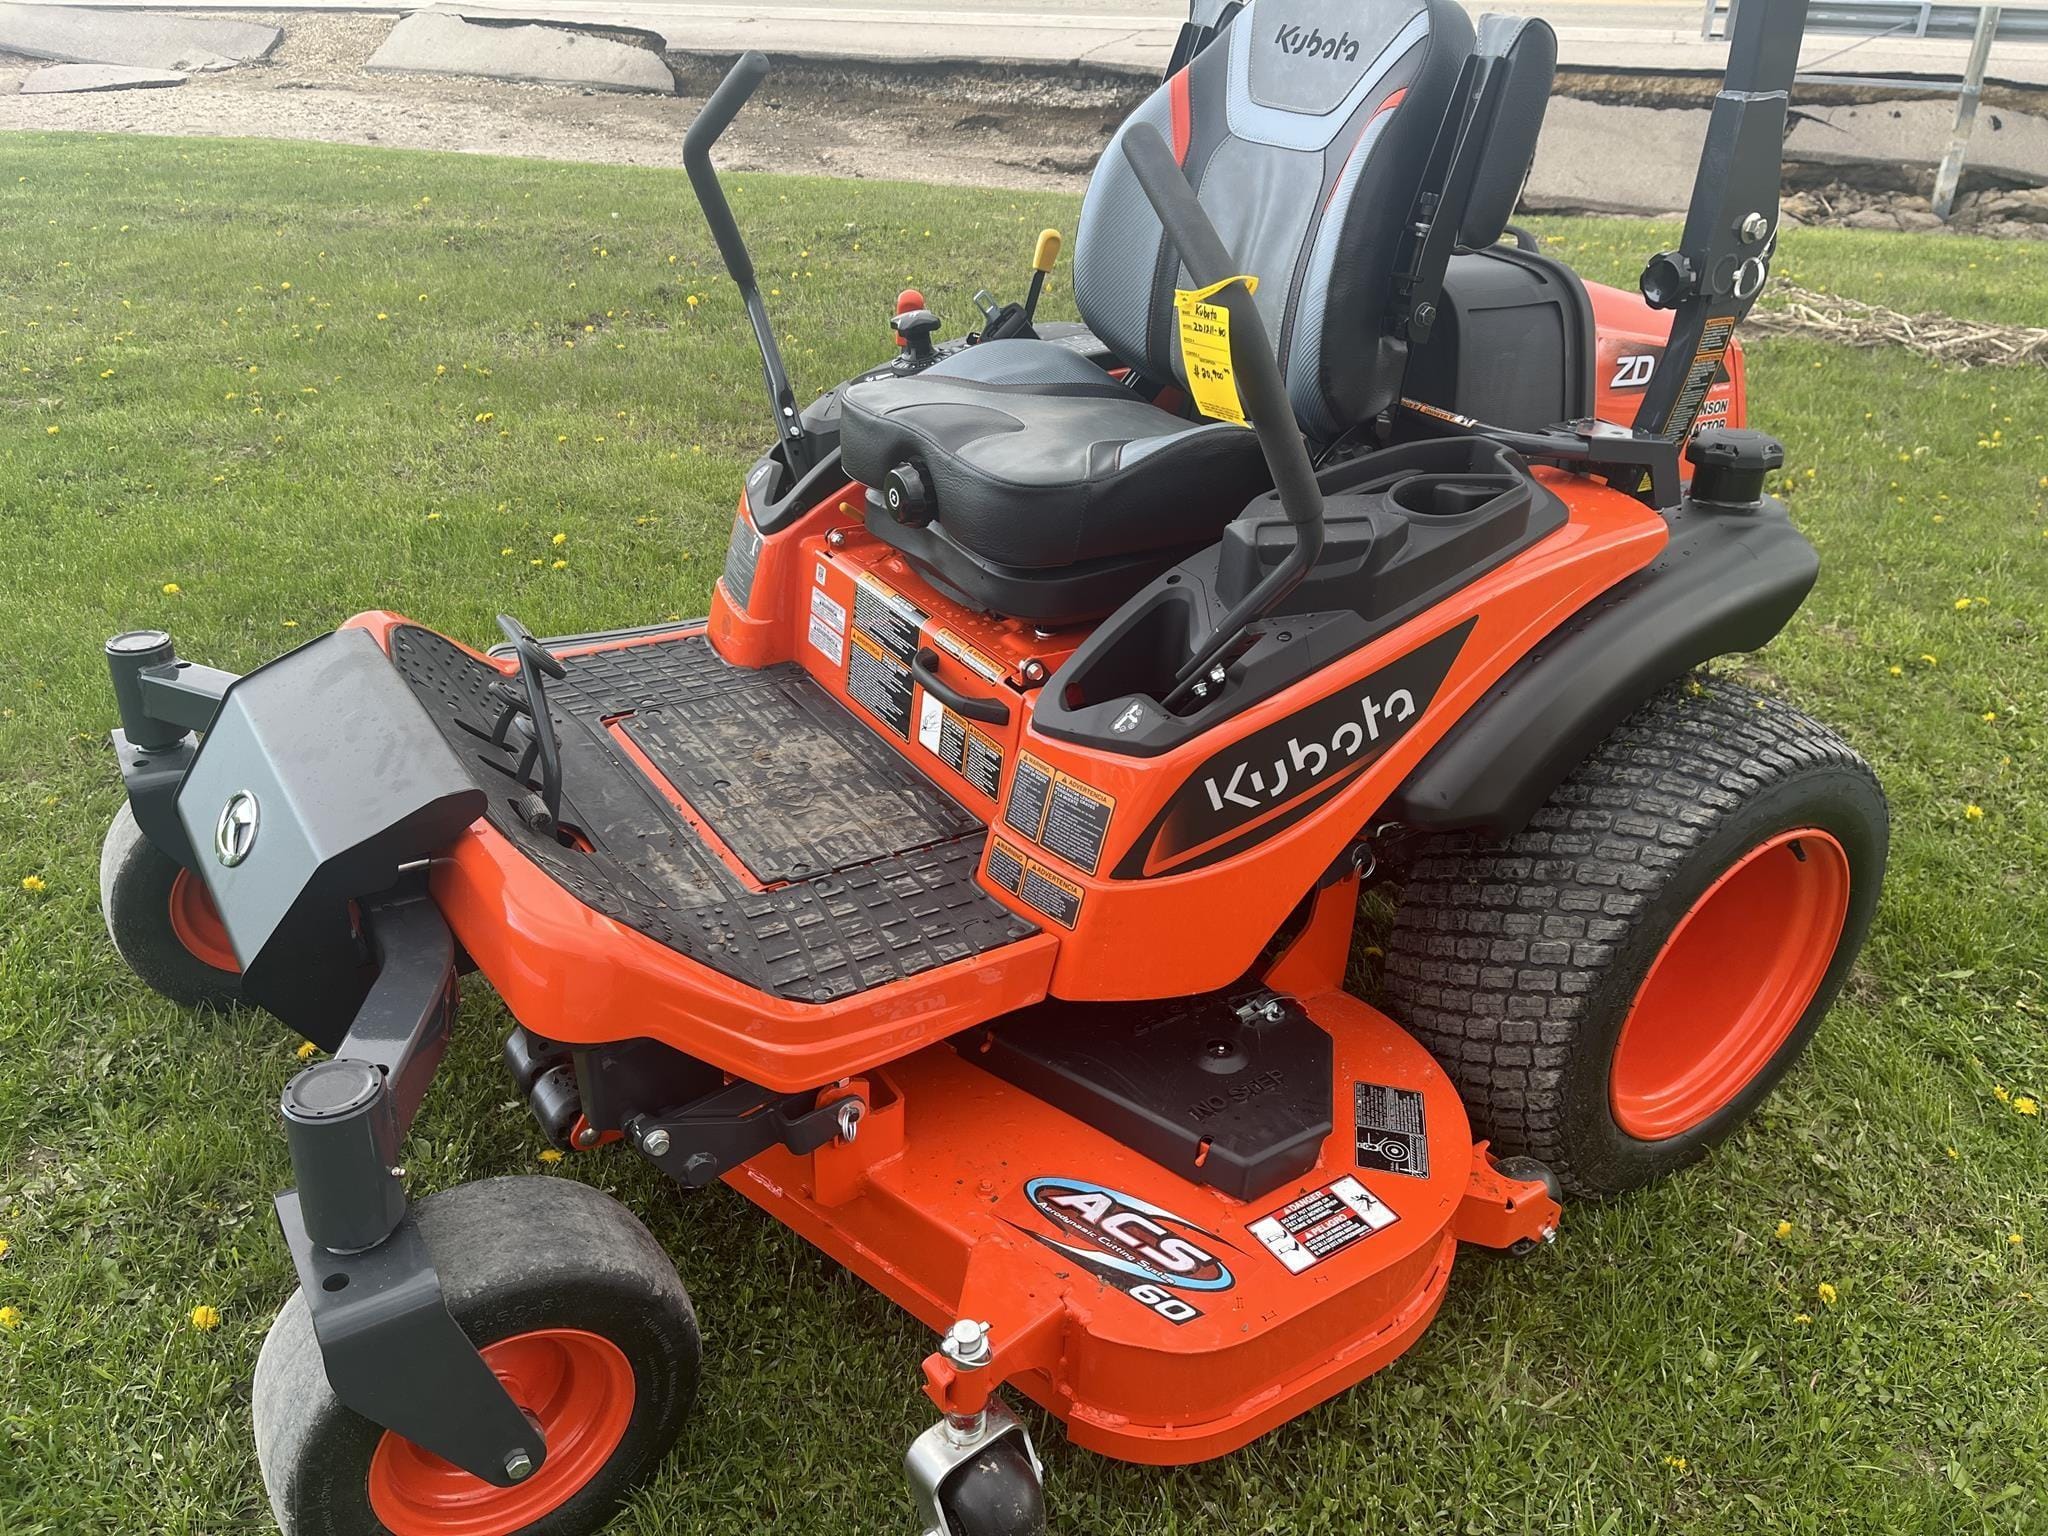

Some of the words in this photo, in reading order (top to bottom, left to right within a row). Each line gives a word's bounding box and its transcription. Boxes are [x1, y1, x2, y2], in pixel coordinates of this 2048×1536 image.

[1275, 24, 1360, 62] Kubota
[1195, 304, 1217, 320] Kubota
[1610, 355, 1655, 388] ZD
[1204, 688, 1416, 811] Kubota
[1069, 779, 1107, 803] ADVERTENCIA
[1037, 867, 1078, 895] ADVERTENCIA
[1289, 1190, 1324, 1212] DANGER
[1036, 1202, 1097, 1238] Aerodynamic
[1098, 1236, 1136, 1261] Cutting
[1048, 1193, 1212, 1271] ACS
[1311, 1213, 1348, 1236] PELIGRO
[1129, 1284, 1196, 1321] 60
